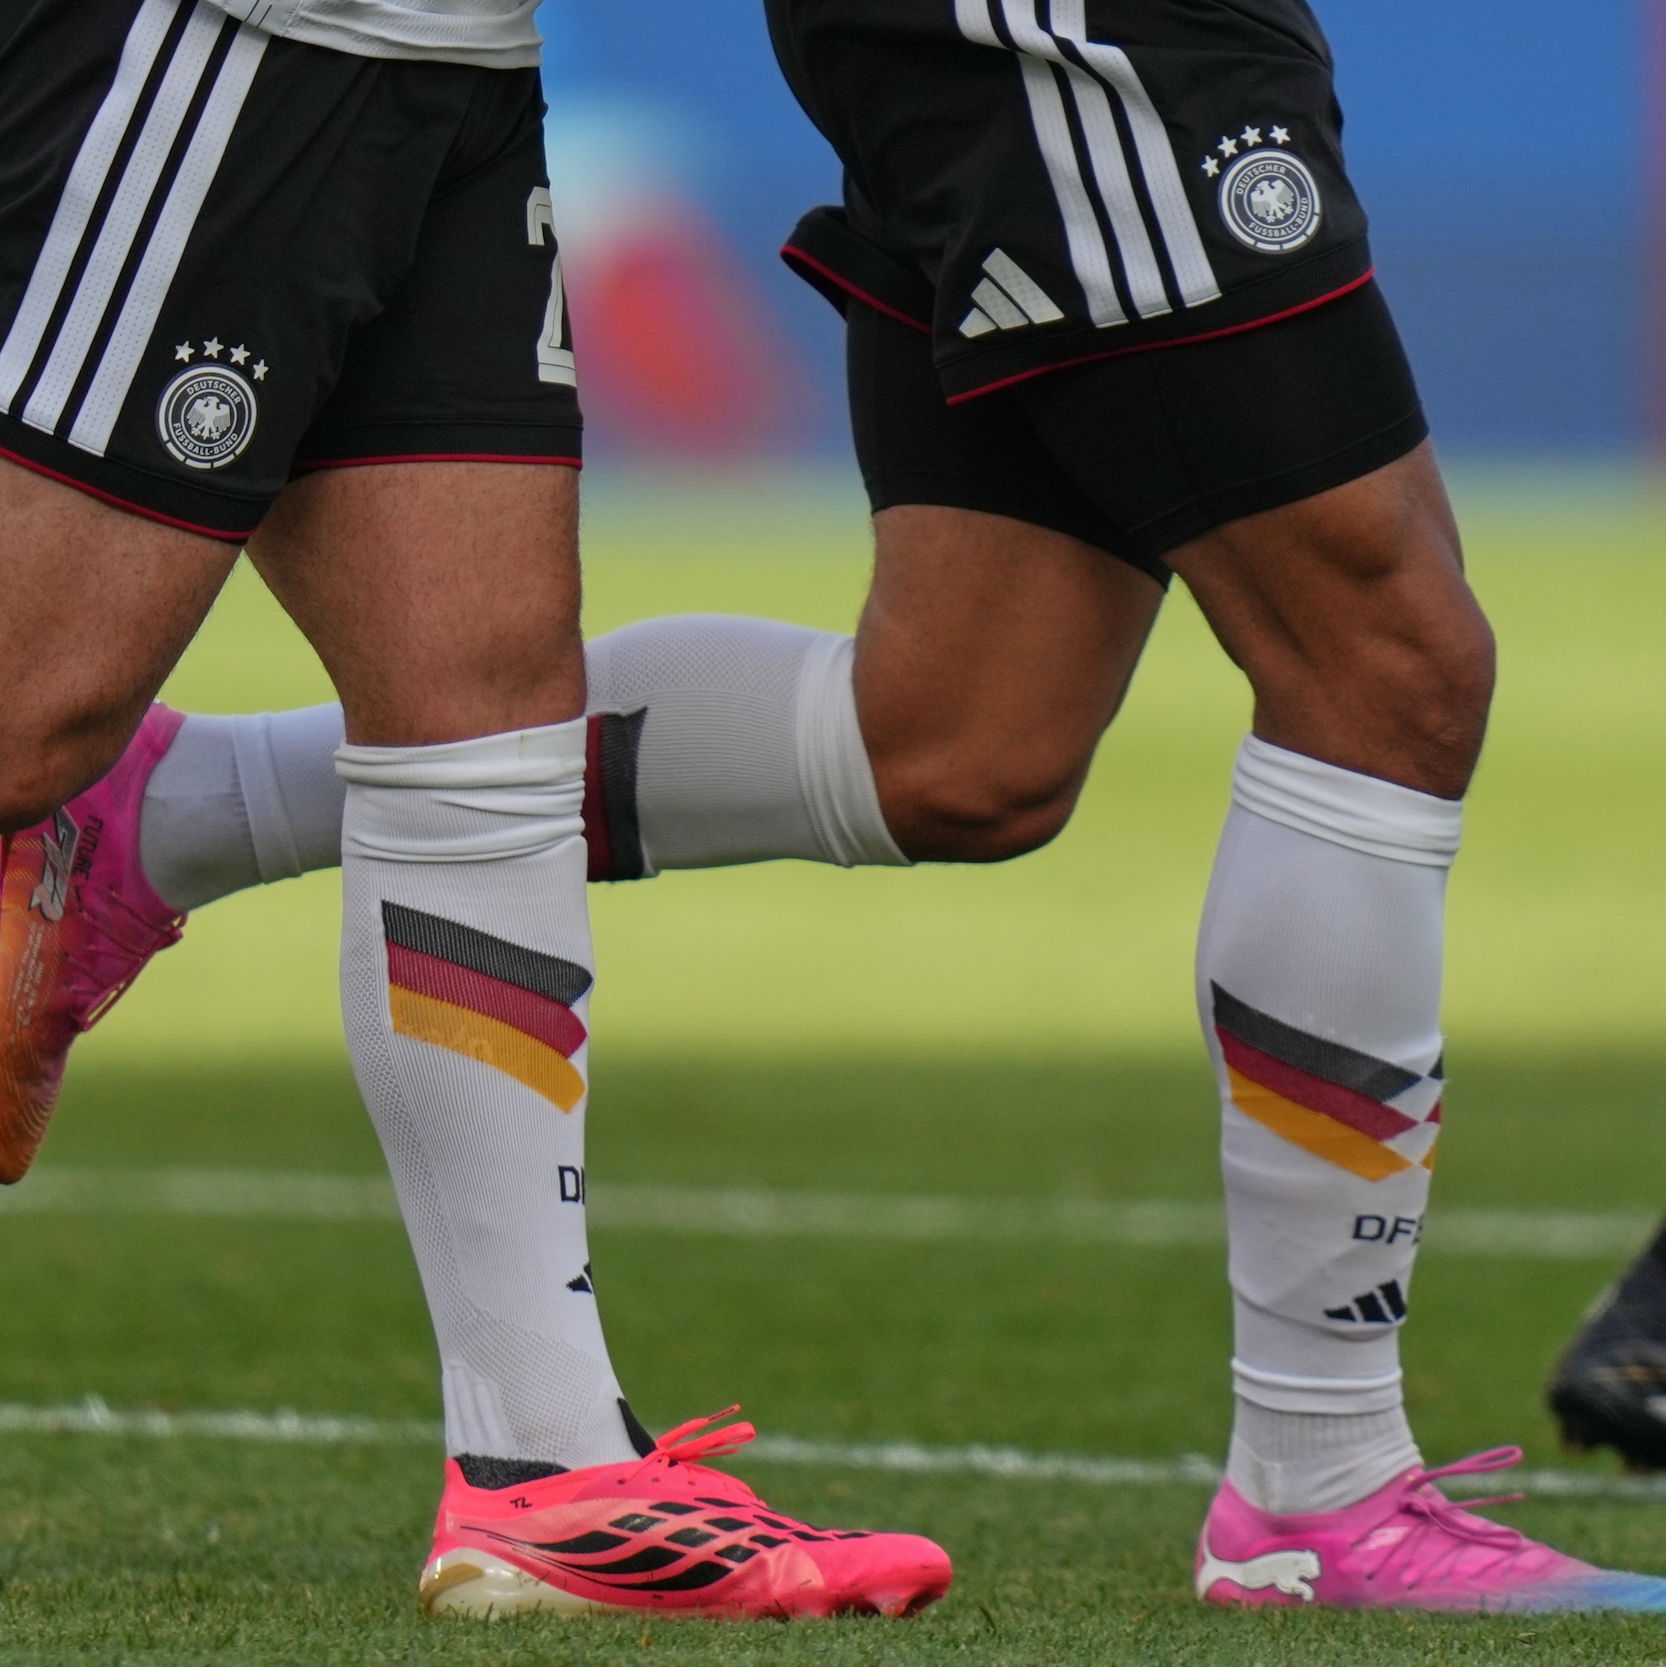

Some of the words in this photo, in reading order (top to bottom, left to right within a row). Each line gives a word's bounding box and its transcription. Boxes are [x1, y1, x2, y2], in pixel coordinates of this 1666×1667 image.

[1235, 164, 1287, 195] DEUTSCHER
[1248, 197, 1308, 238] FUSSBALL-BUND
[186, 380, 242, 405] DEUTSCHER
[173, 422, 238, 455] FUSSBALL-BUND
[73, 814, 104, 881] FUTURE
[558, 1165, 585, 1205] D
